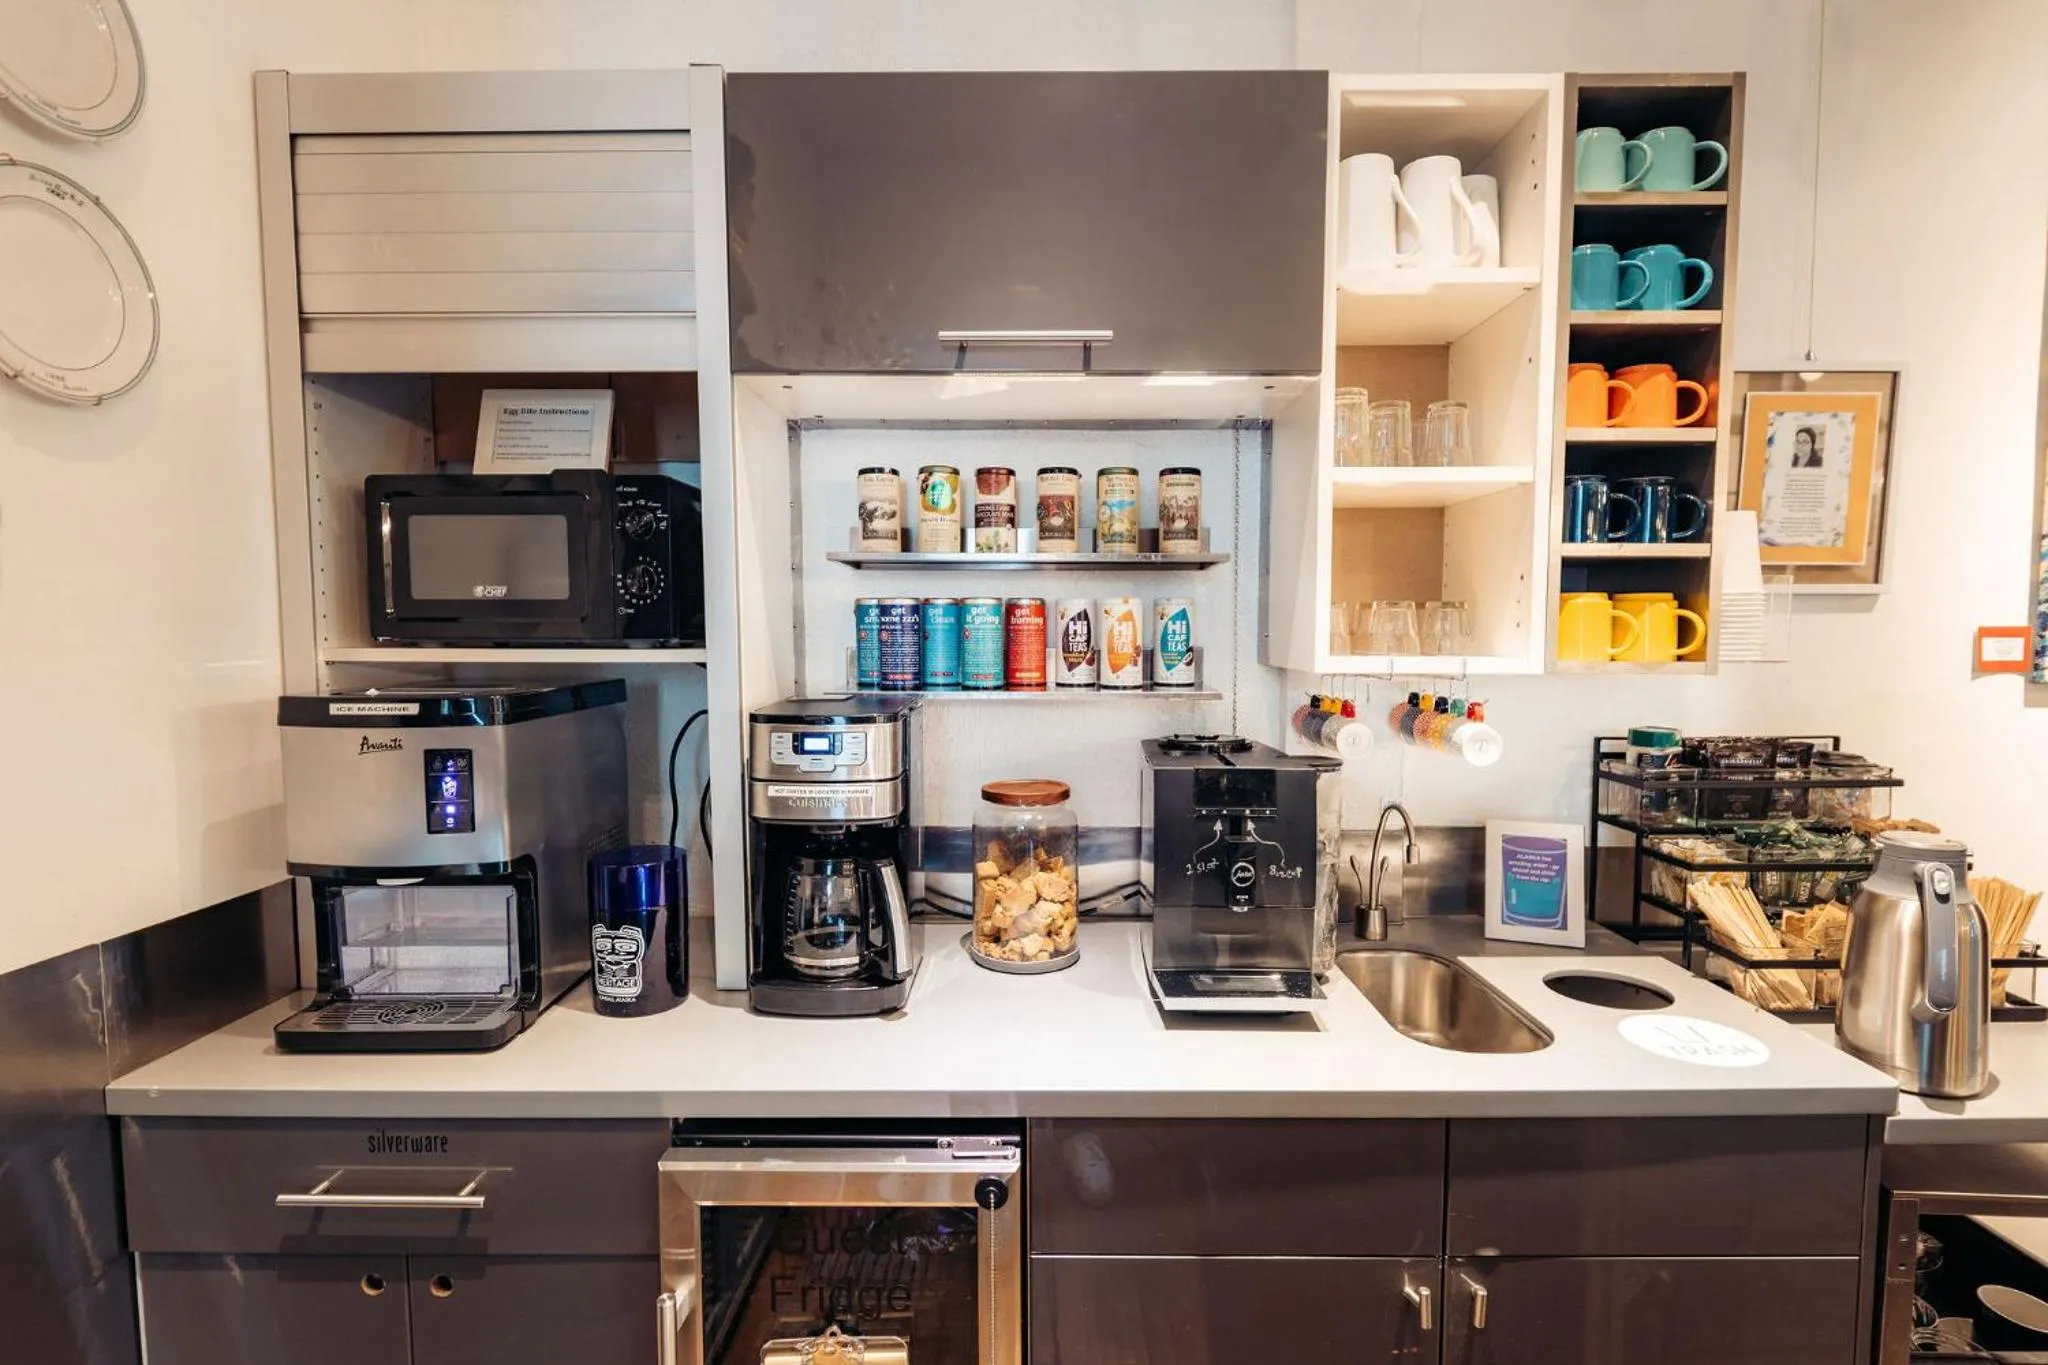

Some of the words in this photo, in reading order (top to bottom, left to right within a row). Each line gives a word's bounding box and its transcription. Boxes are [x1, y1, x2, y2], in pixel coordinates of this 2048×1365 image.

[891, 607, 906, 616] get
[928, 607, 943, 616] get
[971, 607, 986, 615] get
[1015, 608, 1030, 617] get
[974, 615, 999, 625] going
[1011, 615, 1044, 625] burning
[1069, 621, 1087, 634] Hi
[1114, 622, 1133, 635] Hi
[1168, 621, 1187, 634] Hi
[1069, 643, 1087, 652] TEAS
[1114, 643, 1132, 653] TEAS
[1168, 642, 1187, 652] TEAS
[358, 735, 404, 753] Avanti
[368, 1129, 449, 1153] silverware
[771, 1275, 911, 1319] Fridge
